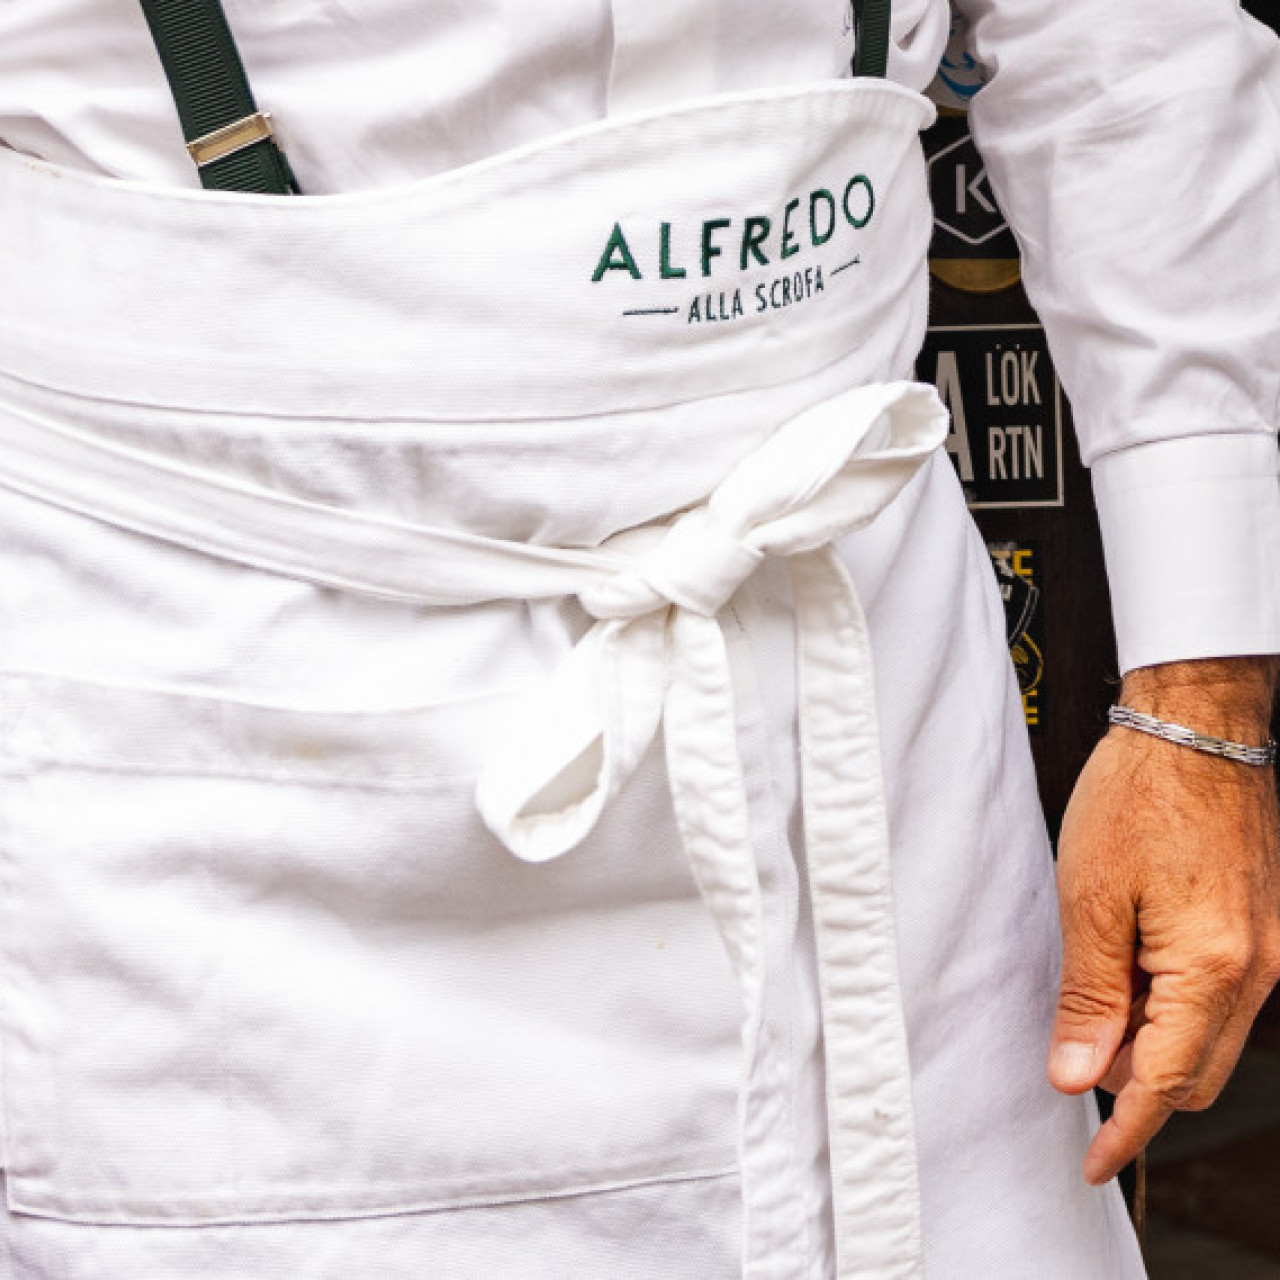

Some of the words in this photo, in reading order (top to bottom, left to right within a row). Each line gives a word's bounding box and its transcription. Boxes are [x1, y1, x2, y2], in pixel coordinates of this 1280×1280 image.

[591, 175, 875, 282] ALFREDO
[688, 288, 744, 324] ALLA
[755, 265, 825, 312] SCROFA
[988, 424, 1045, 480] RTN
